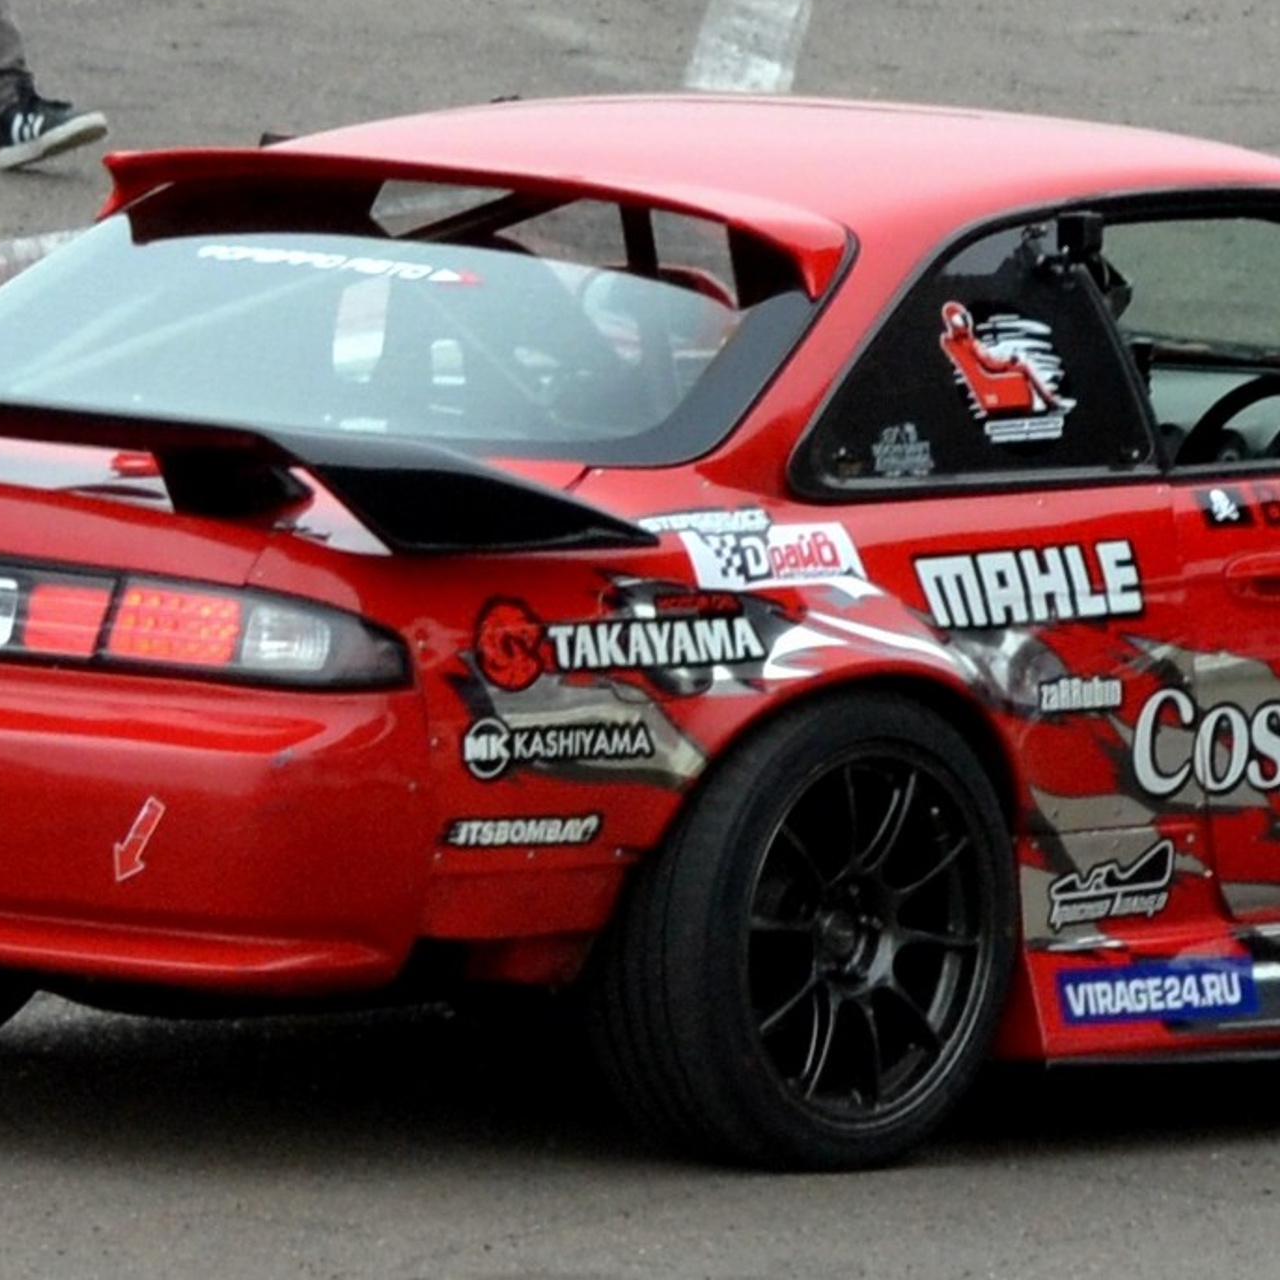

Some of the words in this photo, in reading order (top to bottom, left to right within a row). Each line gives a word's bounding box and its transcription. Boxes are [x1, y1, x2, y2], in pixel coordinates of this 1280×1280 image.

[914, 539, 1143, 628] MAHLE
[549, 618, 764, 668] TAKAYAMA
[464, 733, 510, 762] MK
[513, 726, 652, 760] KASHIYAMA
[1133, 688, 1280, 796] Cos
[1064, 971, 1242, 1018] VIRAGE24.RU
